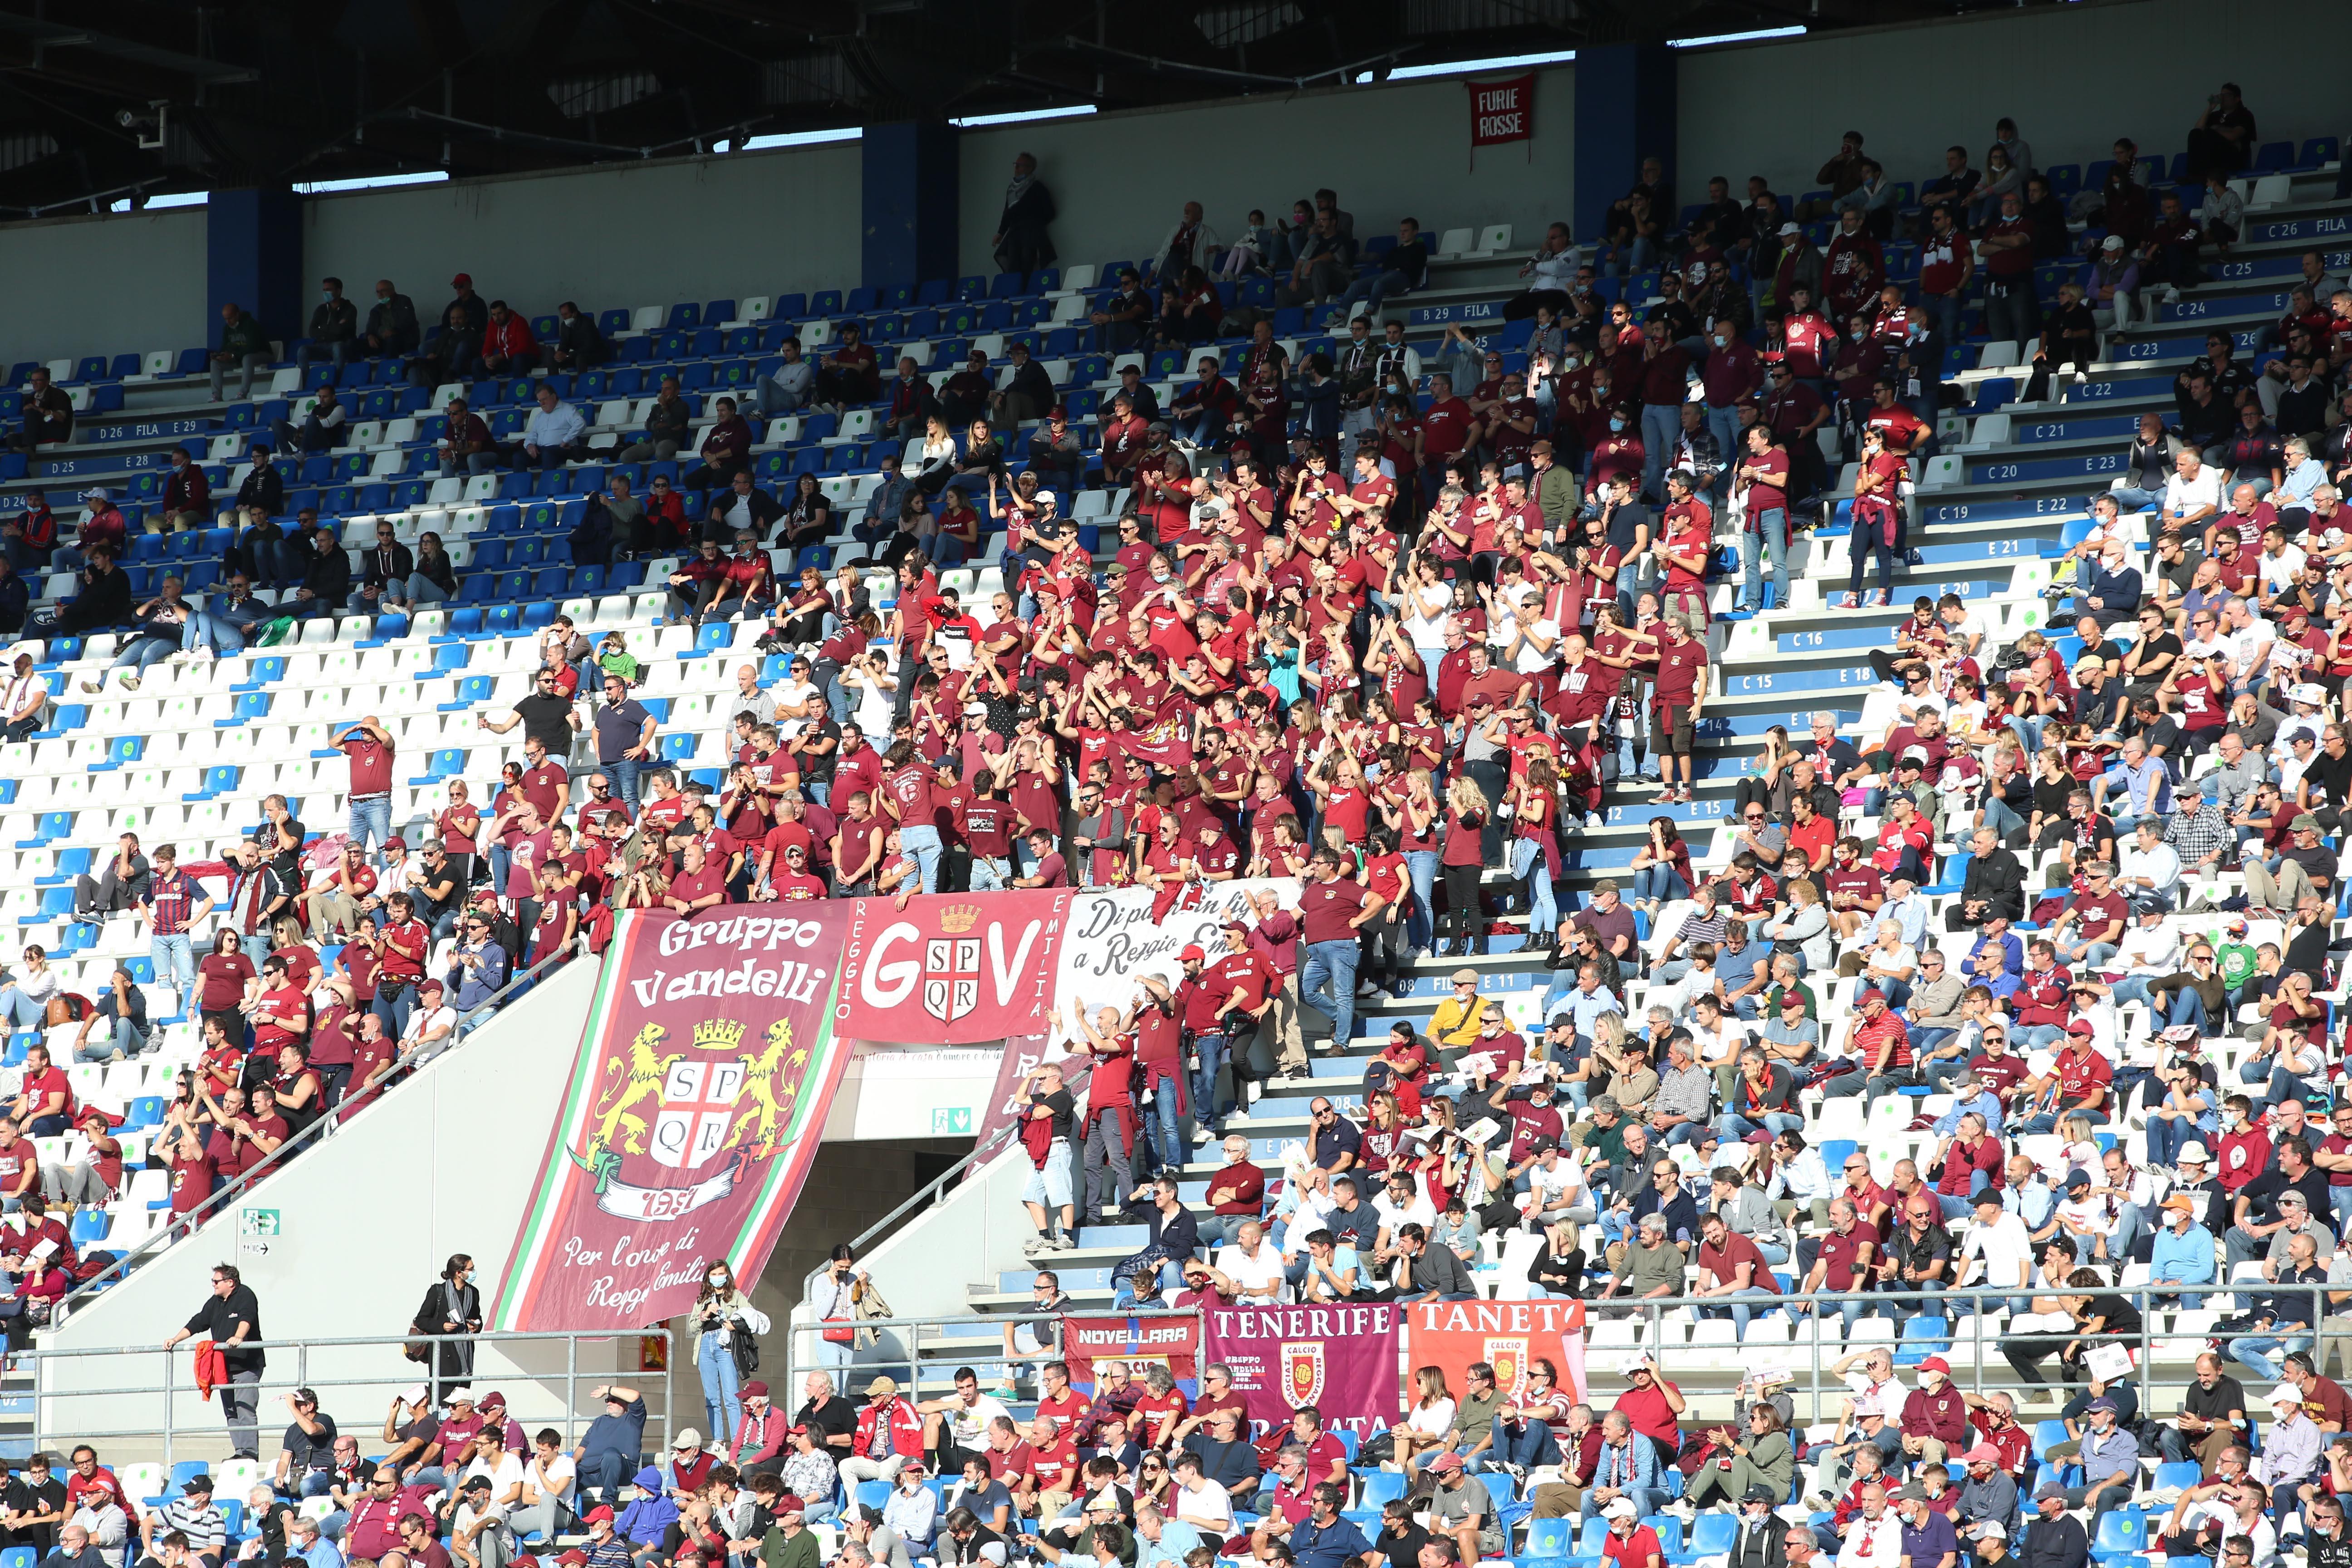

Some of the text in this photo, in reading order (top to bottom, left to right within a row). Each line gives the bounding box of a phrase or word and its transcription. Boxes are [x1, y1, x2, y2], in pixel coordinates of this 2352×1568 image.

[1479, 88, 1519, 113] FURIE
[1480, 113, 1523, 137] ROSSE
[2269, 218, 2346, 237] C 26 FILA
[2223, 253, 2350, 276] C 25 28
[1424, 304, 1490, 320] B 29 FILA
[2177, 294, 2281, 316] C 24 E
[2130, 345, 2136, 357] C
[2142, 343, 2158, 355] 23
[2082, 383, 2111, 397] C 22
[101, 421, 196, 439] D 26 FILA E 29
[2036, 426, 2043, 438] C
[2049, 424, 2063, 436] 21
[53, 455, 148, 473] D 25 E 28
[1989, 456, 2115, 479] C 20 E 23
[4, 498, 9, 507] D
[1940, 498, 2066, 520] C 19 E 22
[1989, 542, 1995, 555] E
[2002, 540, 2018, 554] 21
[1940, 584, 1946, 597] E
[1953, 582, 1970, 595] 20
[1793, 633, 1800, 646] C
[1807, 632, 1823, 645] 16
[1743, 667, 1870, 689] C 15 E 18
[1791, 713, 1798, 726] E
[1741, 758, 1748, 770] E
[1608, 807, 1622, 820] 12
[1691, 800, 1720, 815] E 15
[1078, 898, 1125, 939] Di
[659, 916, 822, 956] Gruppo
[835, 900, 866, 1019] REGGIO
[1074, 953, 1089, 968] a
[1093, 932, 1179, 976] Reggio
[861, 919, 1042, 1009] G V
[631, 958, 826, 1008] Vandelli
[1434, 975, 1456, 991] FIL
[1485, 975, 1491, 988] E
[1499, 974, 1513, 987] 11
[1335, 1096, 1353, 1110] 08
[1267, 1140, 1273, 1152] E
[564, 1236, 603, 1267] Per
[675, 1226, 700, 1251] di
[1214, 1306, 1390, 1338] TENERIFE
[1418, 1302, 1576, 1333] TANET
[1078, 1327, 1188, 1344] NOVELLARA
[1225, 1356, 1260, 1364] GRUPPO
[1305, 1357, 1322, 1406] REGGIANA
